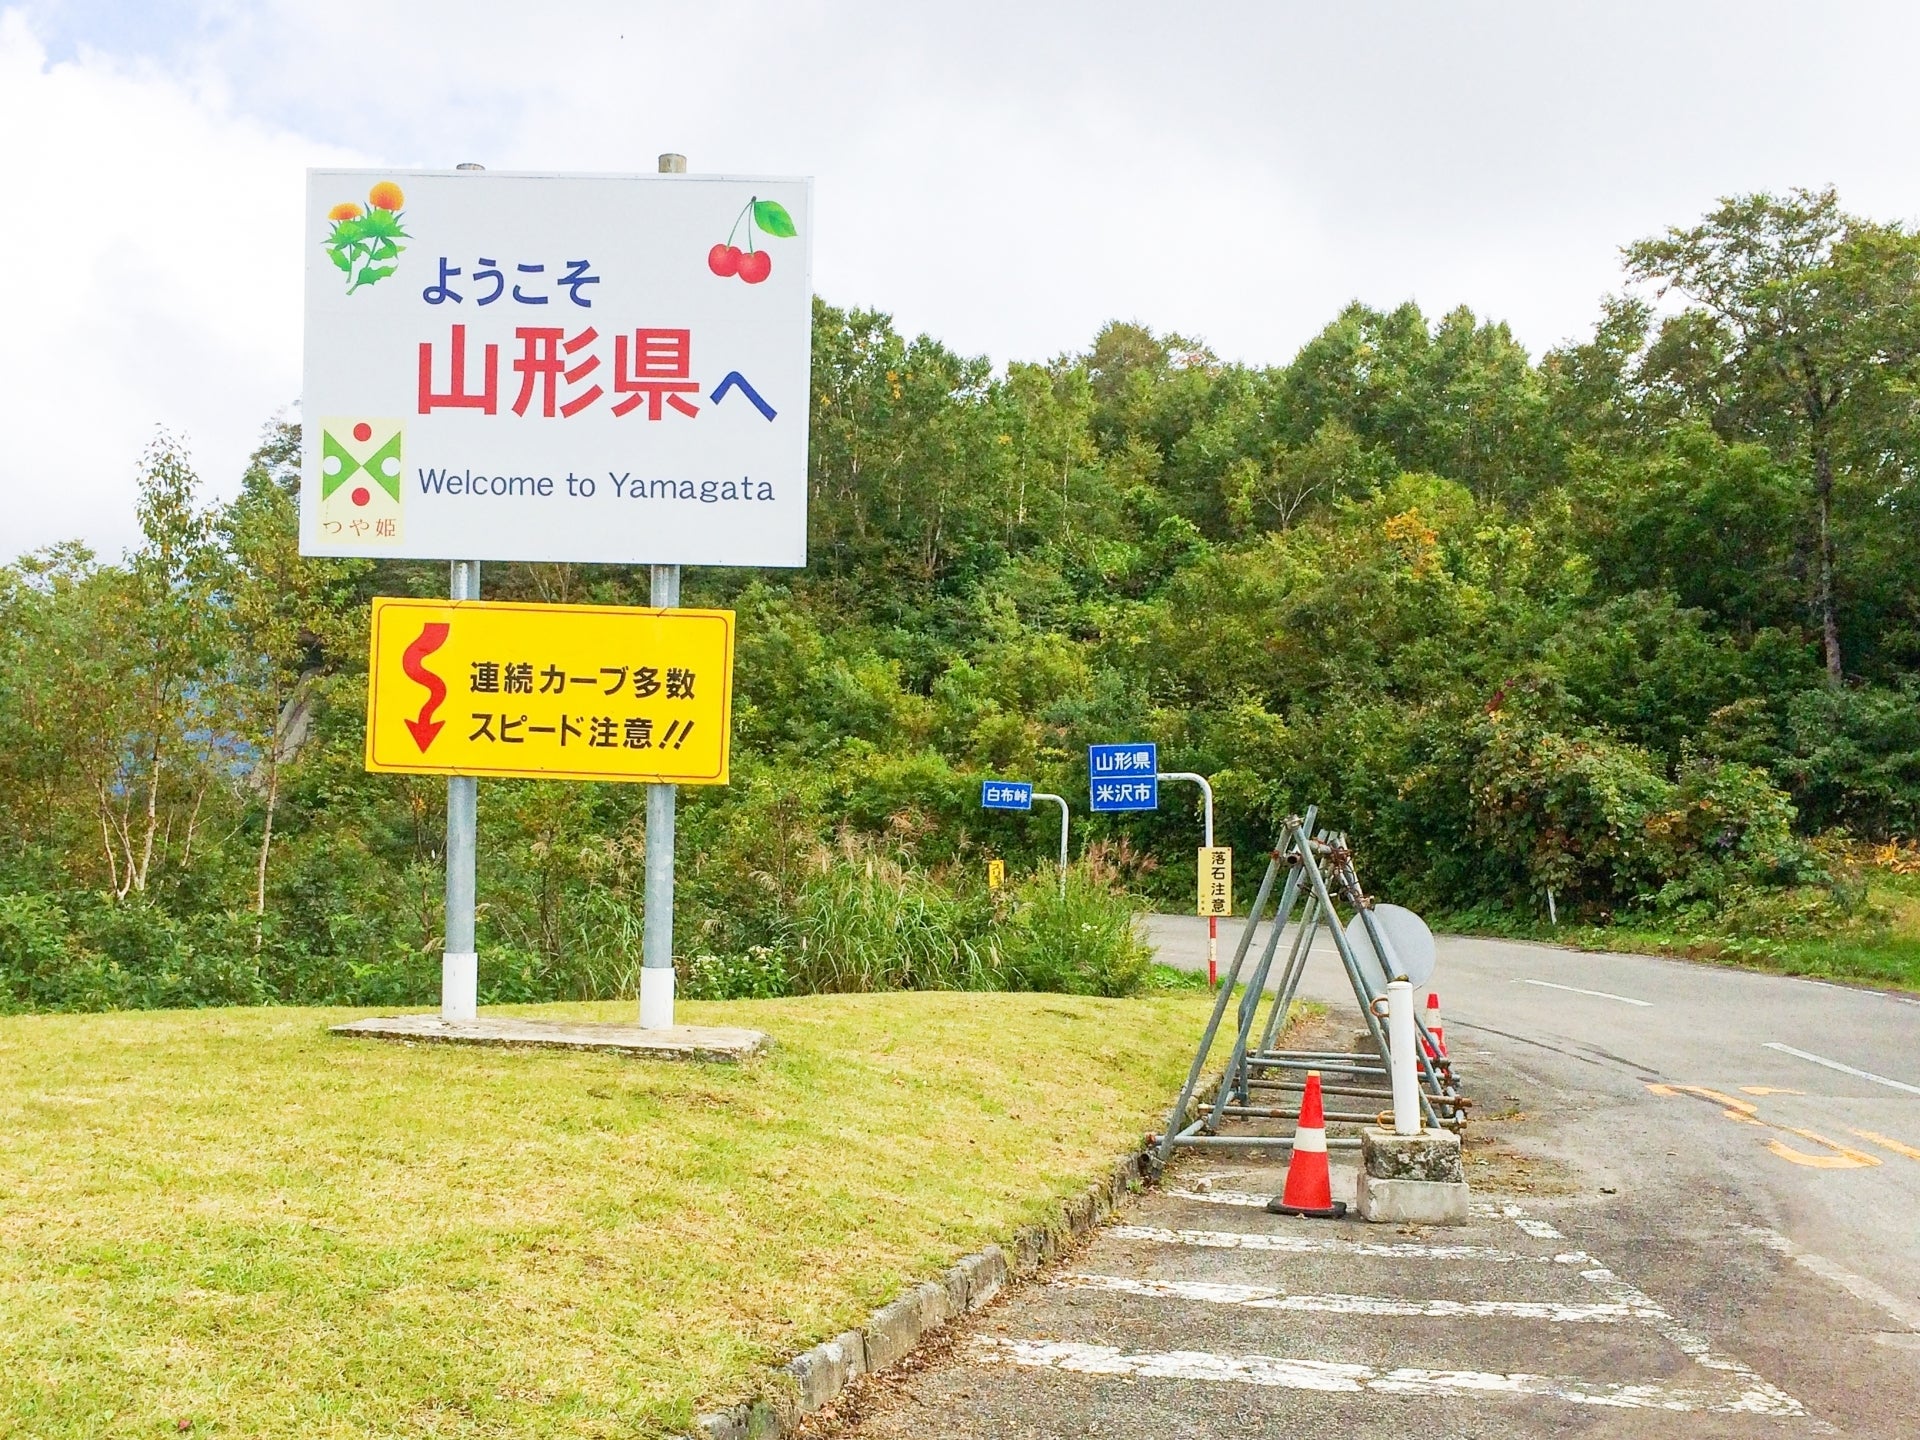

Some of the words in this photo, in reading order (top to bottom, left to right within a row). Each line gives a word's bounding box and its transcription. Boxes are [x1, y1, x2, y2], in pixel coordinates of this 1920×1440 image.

[423, 256, 600, 308] ようこそ
[418, 324, 778, 422] 山形県へ
[418, 468, 554, 496] Welcome
[566, 472, 596, 498] to
[608, 472, 775, 503] Yamagata
[322, 518, 397, 537] つや姫
[470, 661, 696, 700] 連続カーブ多数
[1096, 751, 1151, 771] 山形県
[987, 788, 1028, 803] 白布峠
[1096, 783, 1152, 802] 米沢市
[1211, 851, 1226, 913] 落石注意
